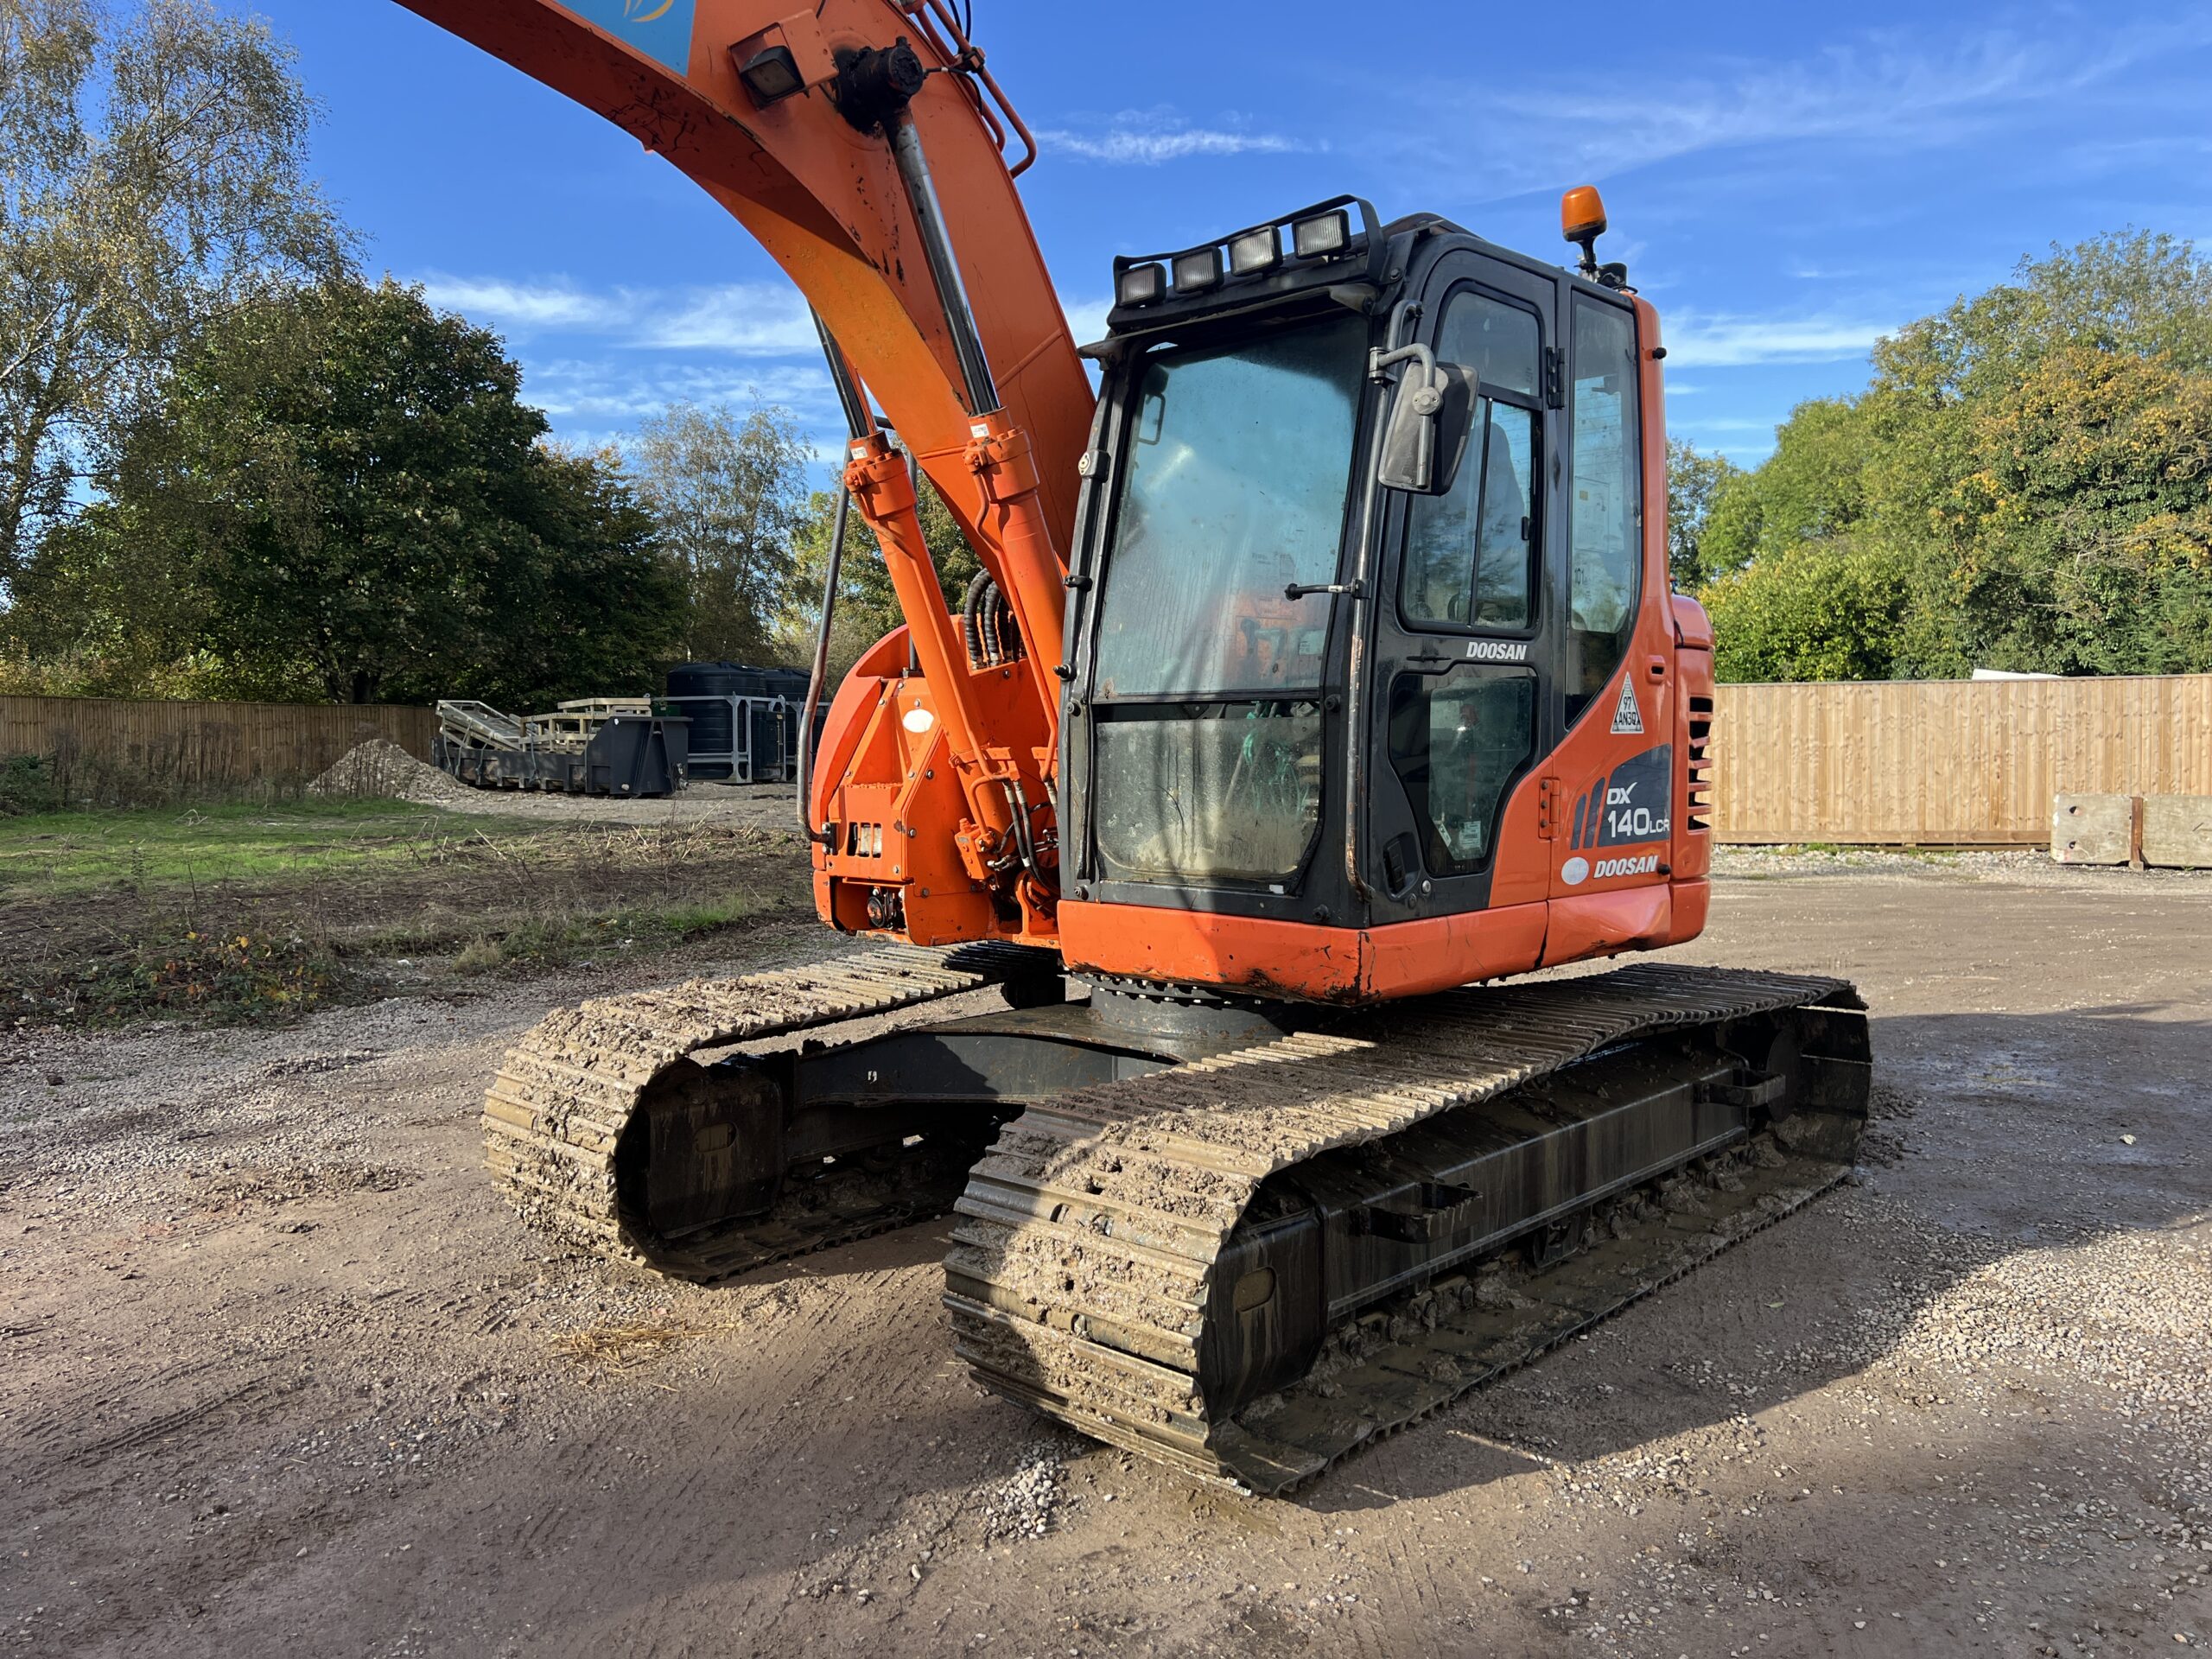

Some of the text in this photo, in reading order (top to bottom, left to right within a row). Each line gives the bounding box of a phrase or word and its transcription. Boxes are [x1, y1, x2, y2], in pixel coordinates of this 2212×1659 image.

[1465, 641, 1527, 660] DOOSAN
[1623, 696, 1631, 710] 97
[1606, 781, 1638, 805] DX
[1593, 855, 1658, 879] DOOSAN
